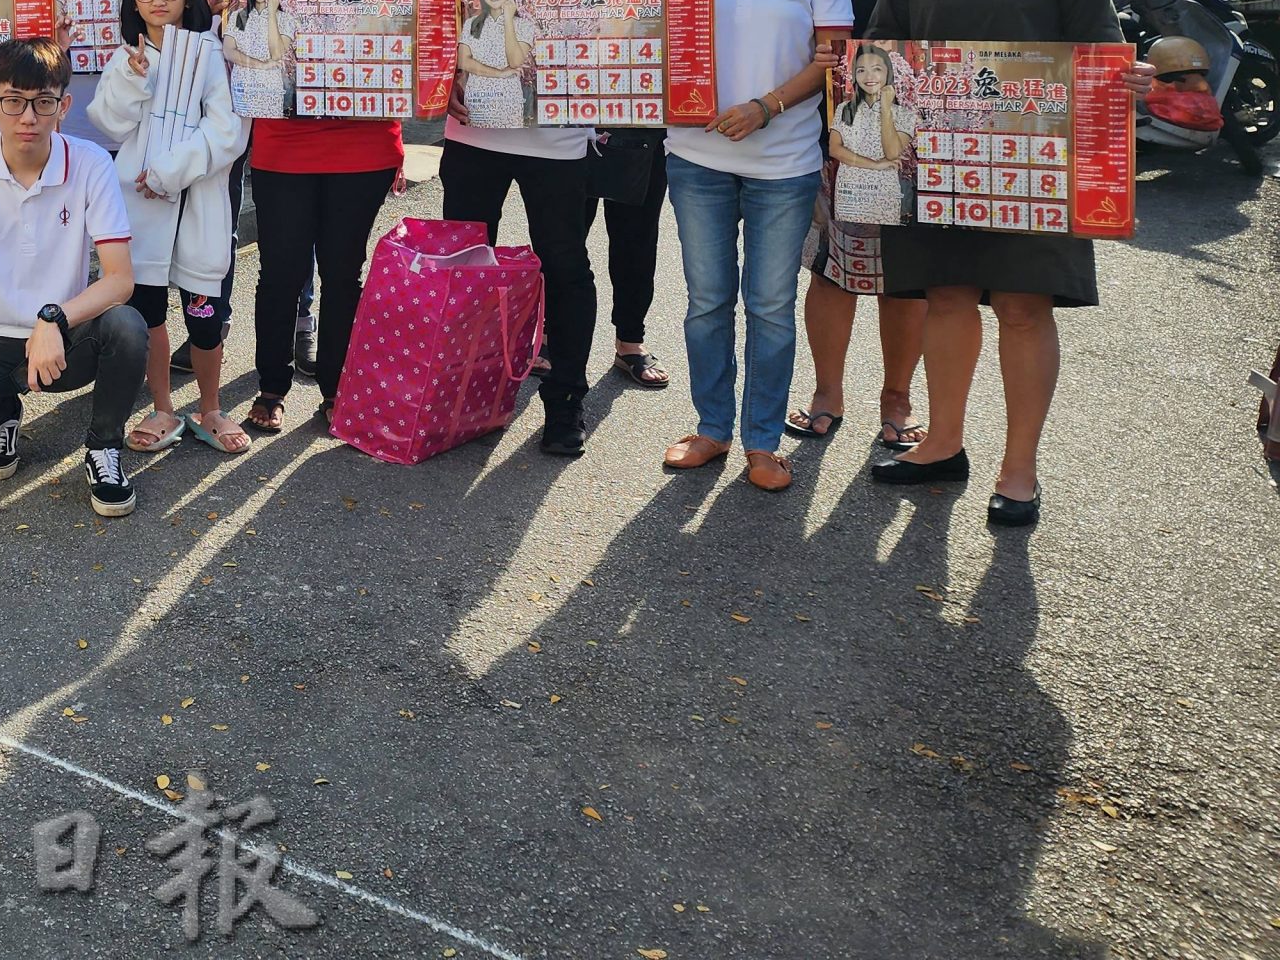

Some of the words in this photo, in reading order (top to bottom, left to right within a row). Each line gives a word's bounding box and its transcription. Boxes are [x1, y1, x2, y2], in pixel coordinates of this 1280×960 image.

[305, 39, 313, 54] 1
[332, 39, 345, 54] 2
[362, 40, 373, 55] 3
[390, 40, 403, 55] 4
[546, 44, 554, 60] 1
[576, 44, 589, 59] 2
[608, 44, 620, 59] 3
[639, 43, 653, 58] 4
[304, 65, 316, 82] 5
[332, 68, 346, 83] 6
[362, 68, 374, 83] 7
[391, 68, 403, 84] 8
[545, 72, 558, 90] 5
[576, 74, 590, 90] 6
[608, 74, 621, 89] 7
[639, 72, 653, 89] 8
[918, 76, 970, 96] 2023
[303, 95, 318, 110] 9
[327, 96, 352, 111] 10
[360, 97, 375, 111] 11
[387, 97, 408, 113] 12
[544, 103, 560, 119] 9
[571, 103, 597, 119] 10
[606, 104, 623, 118] 11
[635, 103, 659, 120] 12
[927, 137, 938, 154] 1
[962, 138, 978, 155] 2
[1001, 140, 1016, 157] 3
[1038, 141, 1056, 158] 4
[926, 167, 941, 186] 5
[962, 170, 980, 188] 6
[1000, 172, 1016, 190] 7
[1039, 173, 1056, 192] 8
[925, 200, 943, 218] 9
[956, 203, 988, 221] 10
[998, 206, 1019, 223] 11
[1034, 208, 1063, 228] 12
[852, 239, 865, 252] 2
[852, 259, 867, 272] 6
[831, 264, 841, 279] 9
[847, 277, 874, 291] 10
